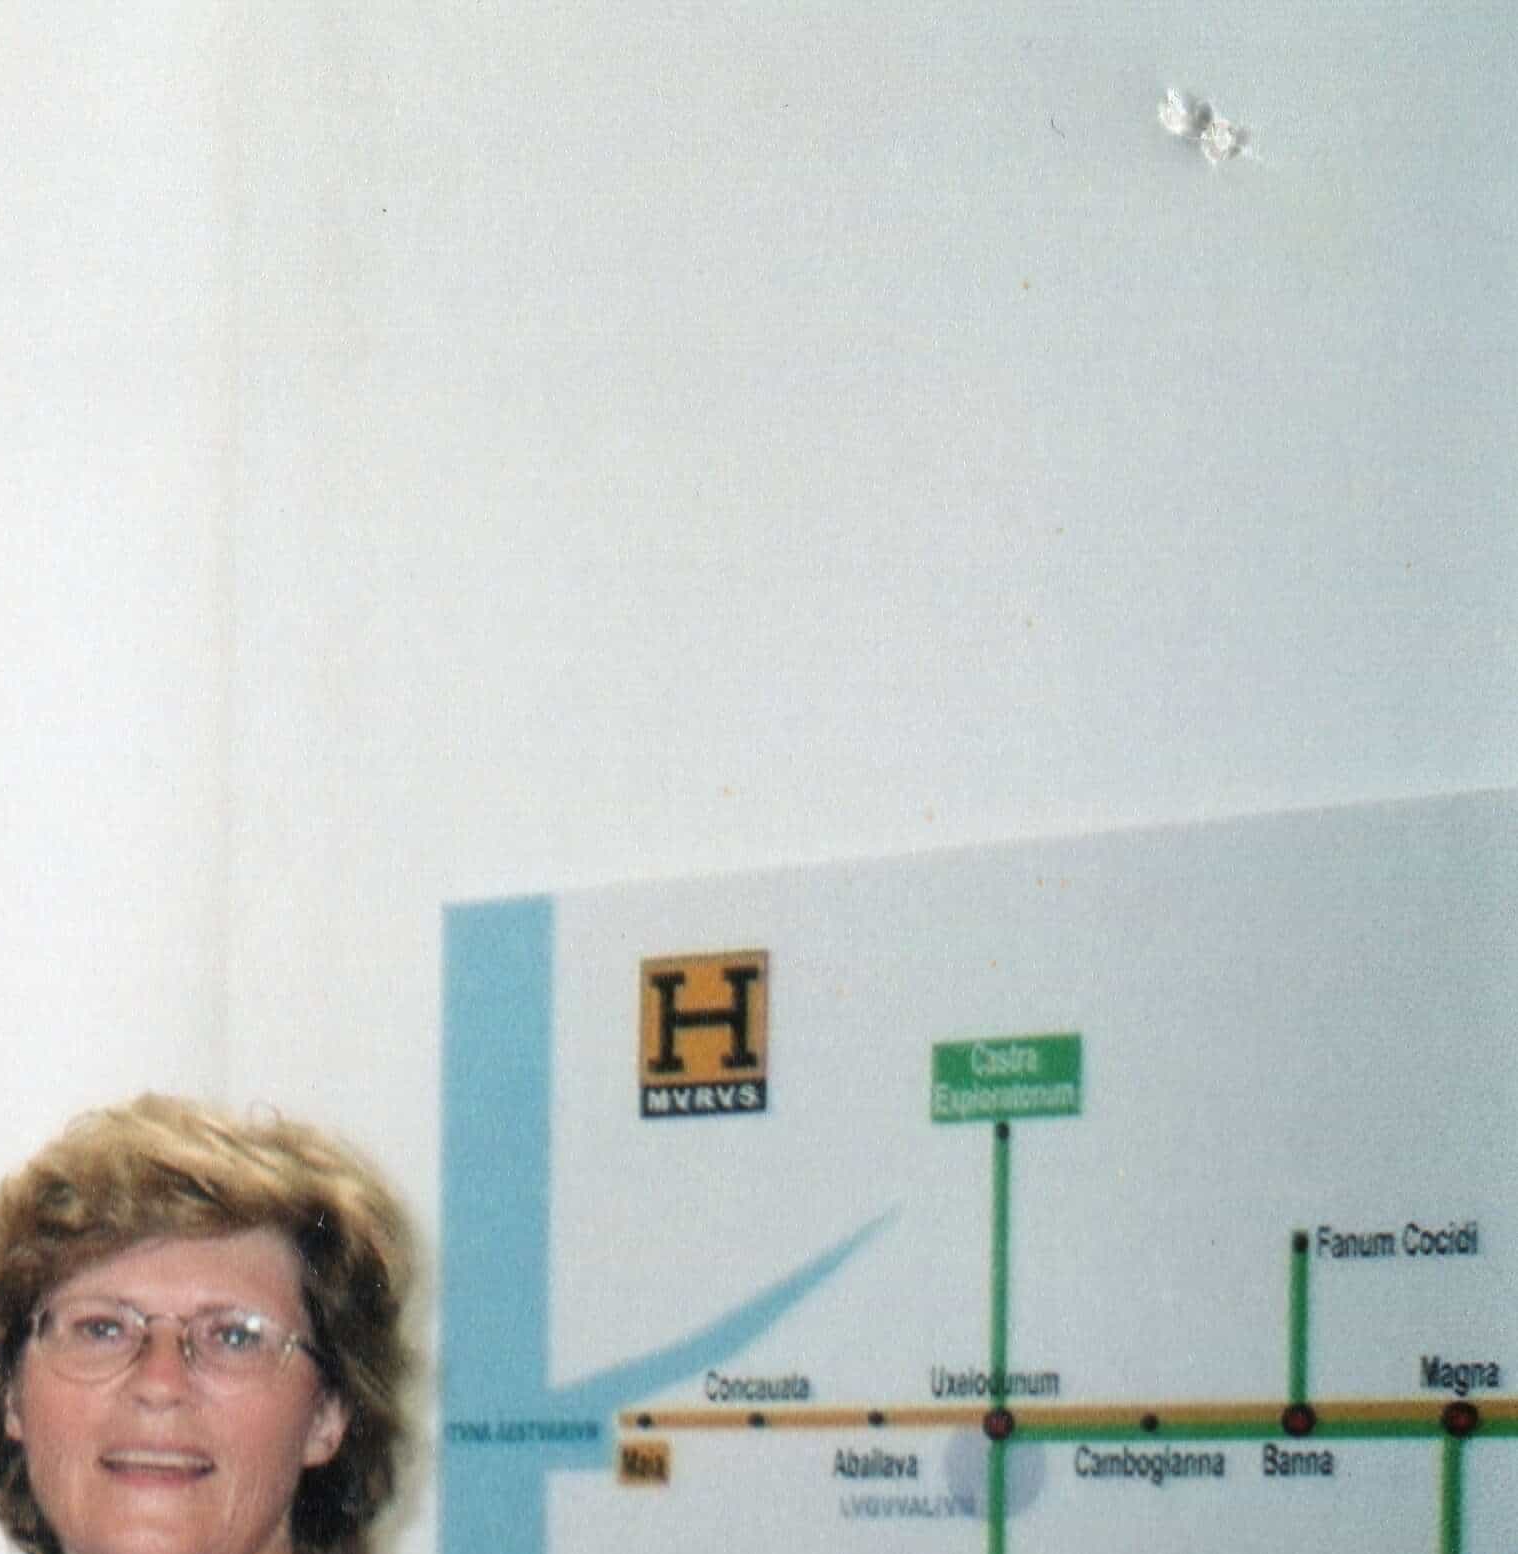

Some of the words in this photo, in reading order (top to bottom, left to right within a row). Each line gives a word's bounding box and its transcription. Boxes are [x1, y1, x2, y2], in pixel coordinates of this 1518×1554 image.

[648, 967, 759, 1073] H
[1317, 1227, 1396, 1258] Fanum
[1402, 1222, 1479, 1256] Cocidi
[1420, 1356, 1500, 1394] Magna
[1263, 1443, 1334, 1477] Banna
